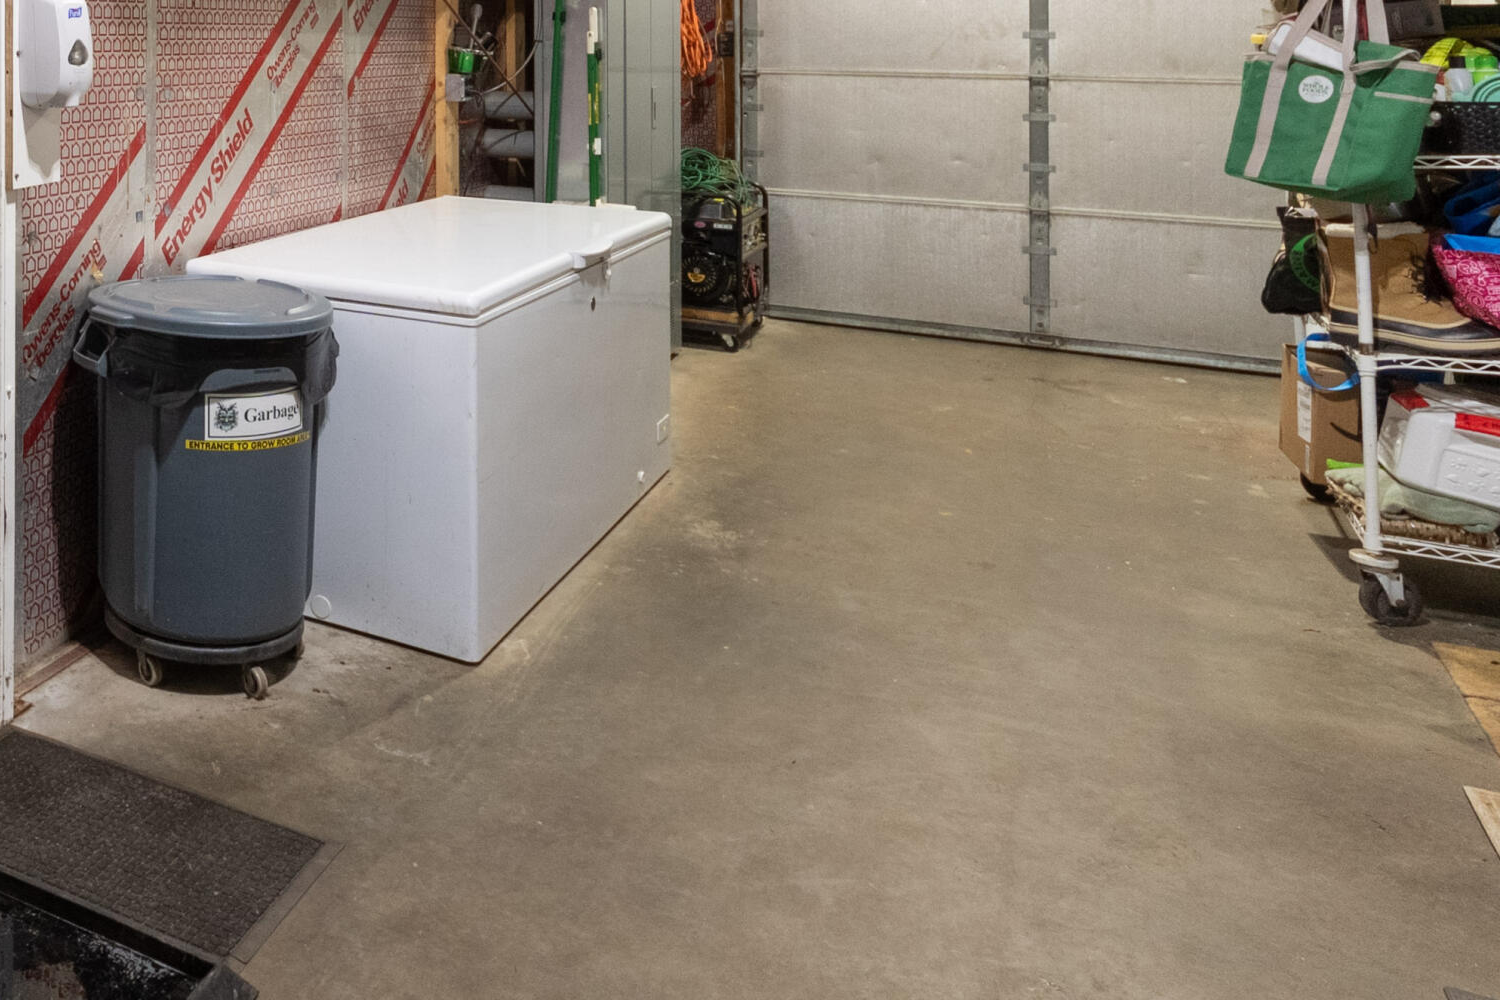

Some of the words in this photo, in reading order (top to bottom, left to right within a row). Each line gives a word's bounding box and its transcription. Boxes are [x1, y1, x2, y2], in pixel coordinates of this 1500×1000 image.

[160, 177, 214, 268] Energy
[210, 107, 254, 185] Shield
[244, 404, 300, 423] Garbage
[188, 440, 235, 451] ENTRANCE
[237, 442, 249, 451] TO
[251, 440, 275, 450] GROW
[276, 437, 296, 448] ROOM
